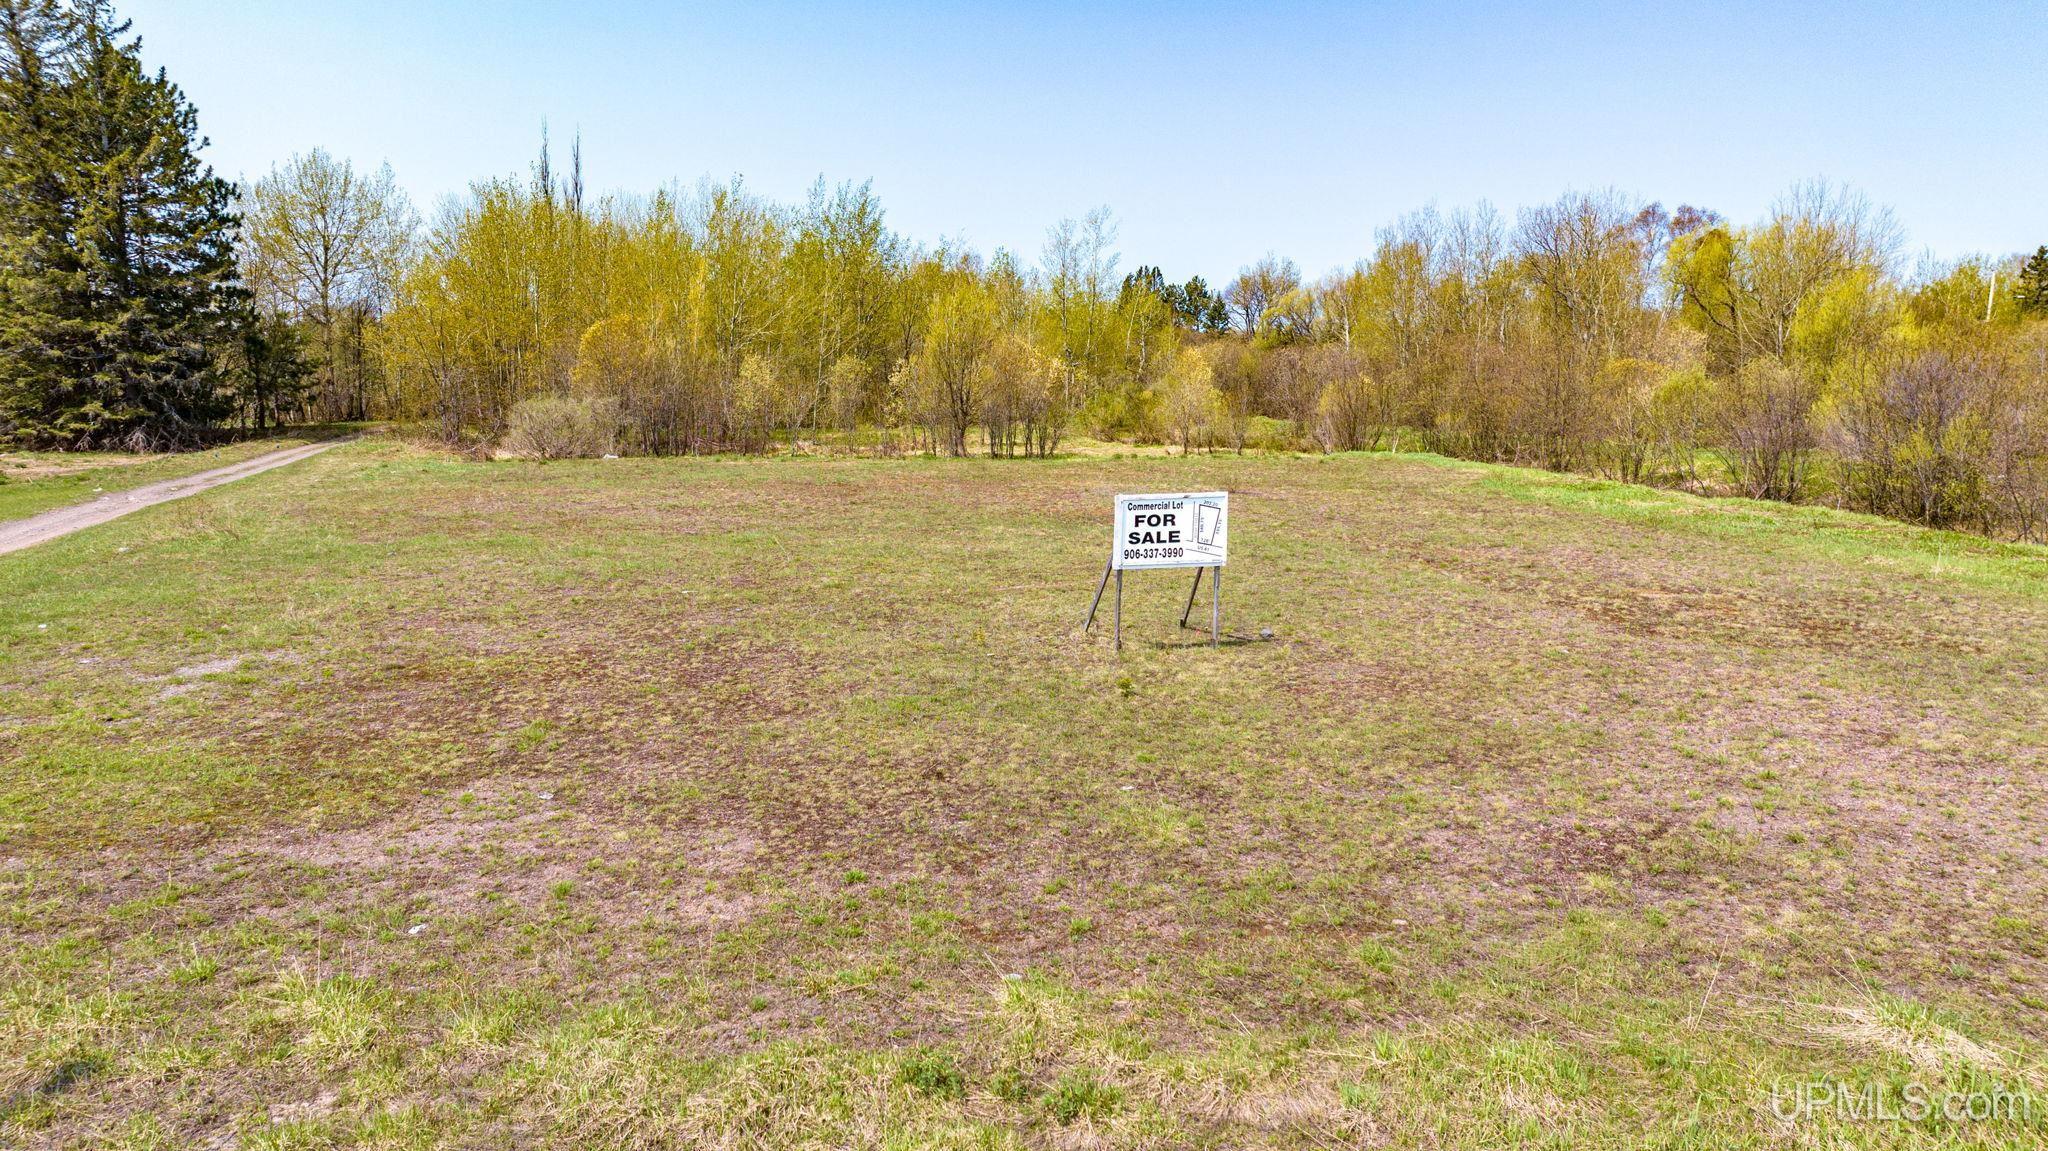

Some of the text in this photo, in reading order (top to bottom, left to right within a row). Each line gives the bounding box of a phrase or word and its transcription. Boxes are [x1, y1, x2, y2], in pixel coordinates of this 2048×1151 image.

[1127, 501, 1184, 511] Commercial Lot
[1134, 514, 1176, 527] FOR
[1128, 531, 1181, 544] SALE
[1124, 547, 1184, 559] 906-337-3990
